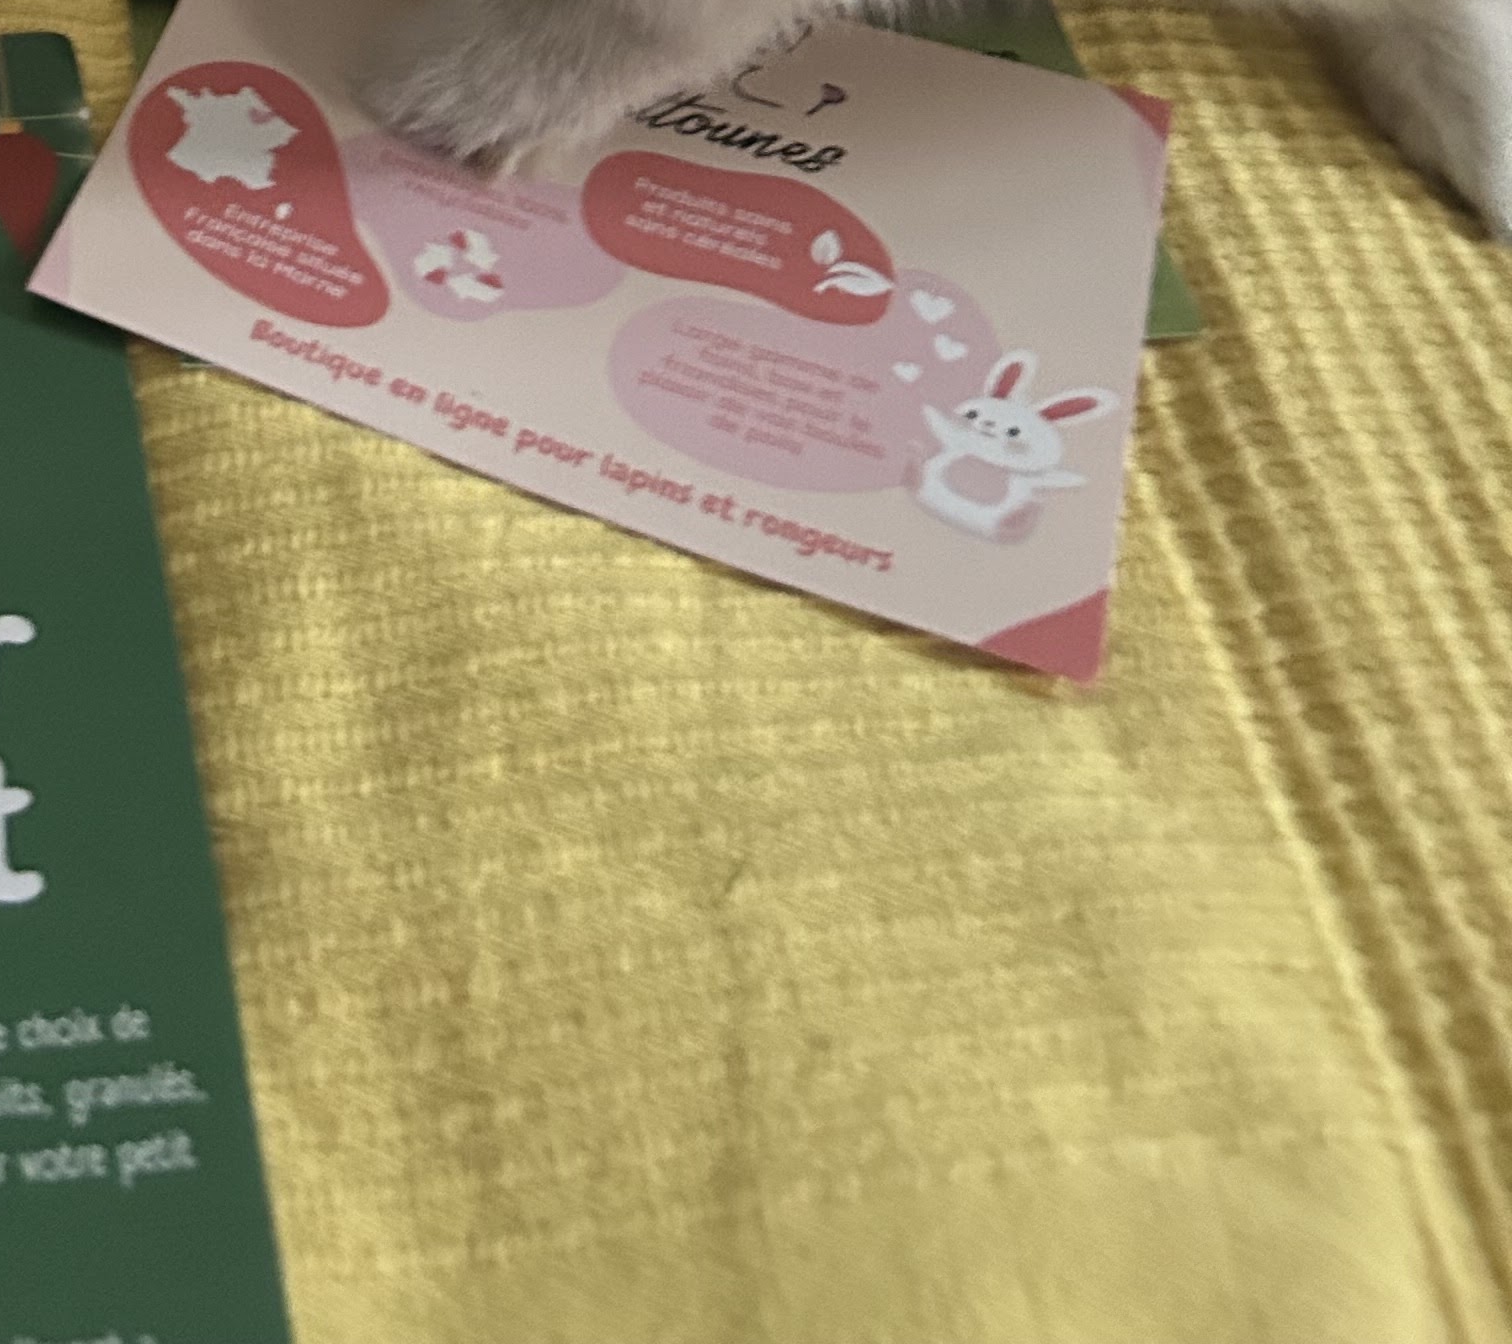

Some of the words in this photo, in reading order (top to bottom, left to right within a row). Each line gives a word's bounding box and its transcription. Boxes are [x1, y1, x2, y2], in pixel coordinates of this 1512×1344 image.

[250, 318, 383, 386] Boutique
[389, 377, 428, 405] en
[434, 391, 510, 437] ligne
[513, 427, 594, 468] pour
[599, 453, 694, 505] lapins
[699, 493, 735, 522] et
[743, 508, 895, 574] rongeurs
[17, 1006, 106, 1051] choix
[111, 1001, 152, 1042] de
[20, 1142, 109, 1183] votre
[116, 1127, 197, 1192] petit
